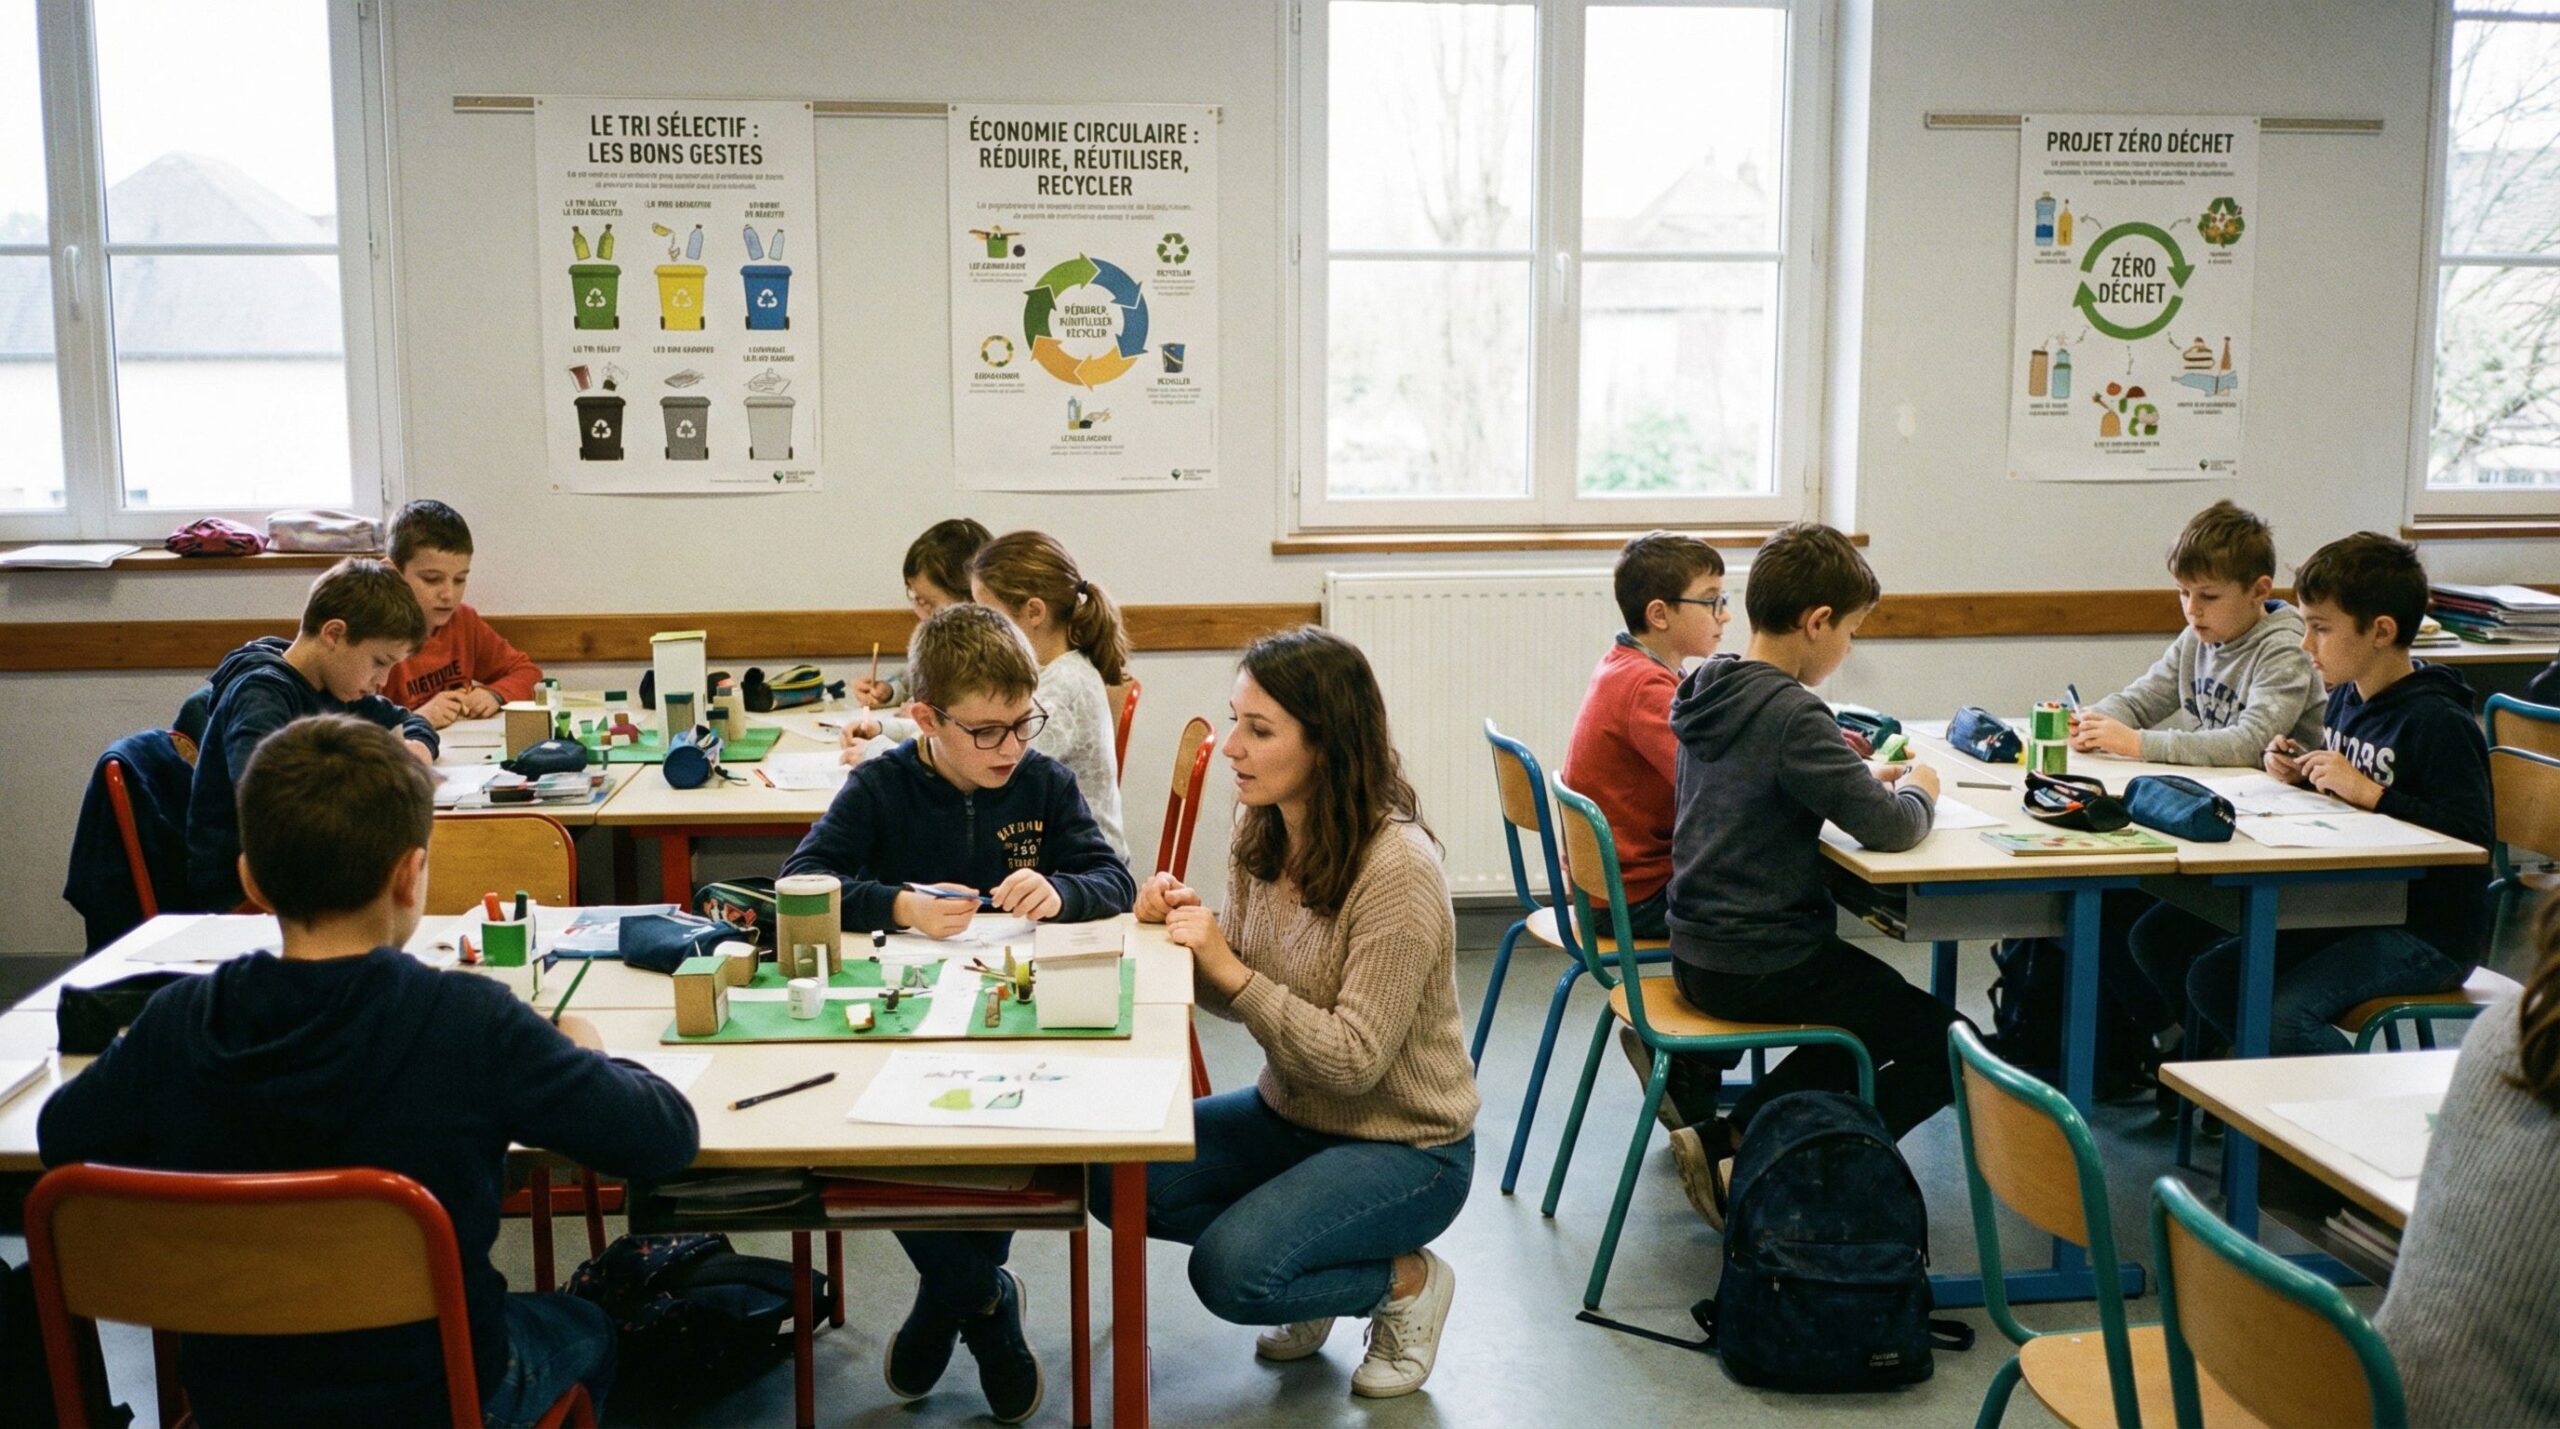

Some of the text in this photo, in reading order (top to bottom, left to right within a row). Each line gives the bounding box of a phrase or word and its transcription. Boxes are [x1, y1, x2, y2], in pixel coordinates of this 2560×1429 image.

[591, 111, 759, 138] LE TRI SÉLECTIF :
[969, 115, 1199, 144] ÉCONOMIE CIRCULAIRE :
[2047, 128, 2234, 153] PROJET ZÉRO DÉCHET
[588, 142, 763, 165] LES BONS GESTES
[979, 144, 1189, 173] RÉDUIRE, RÉUTILISER,
[1037, 175, 1133, 196] RECYCLER
[2111, 252, 2156, 277] ZÉRO
[2099, 280, 2166, 303] DÉCHET
